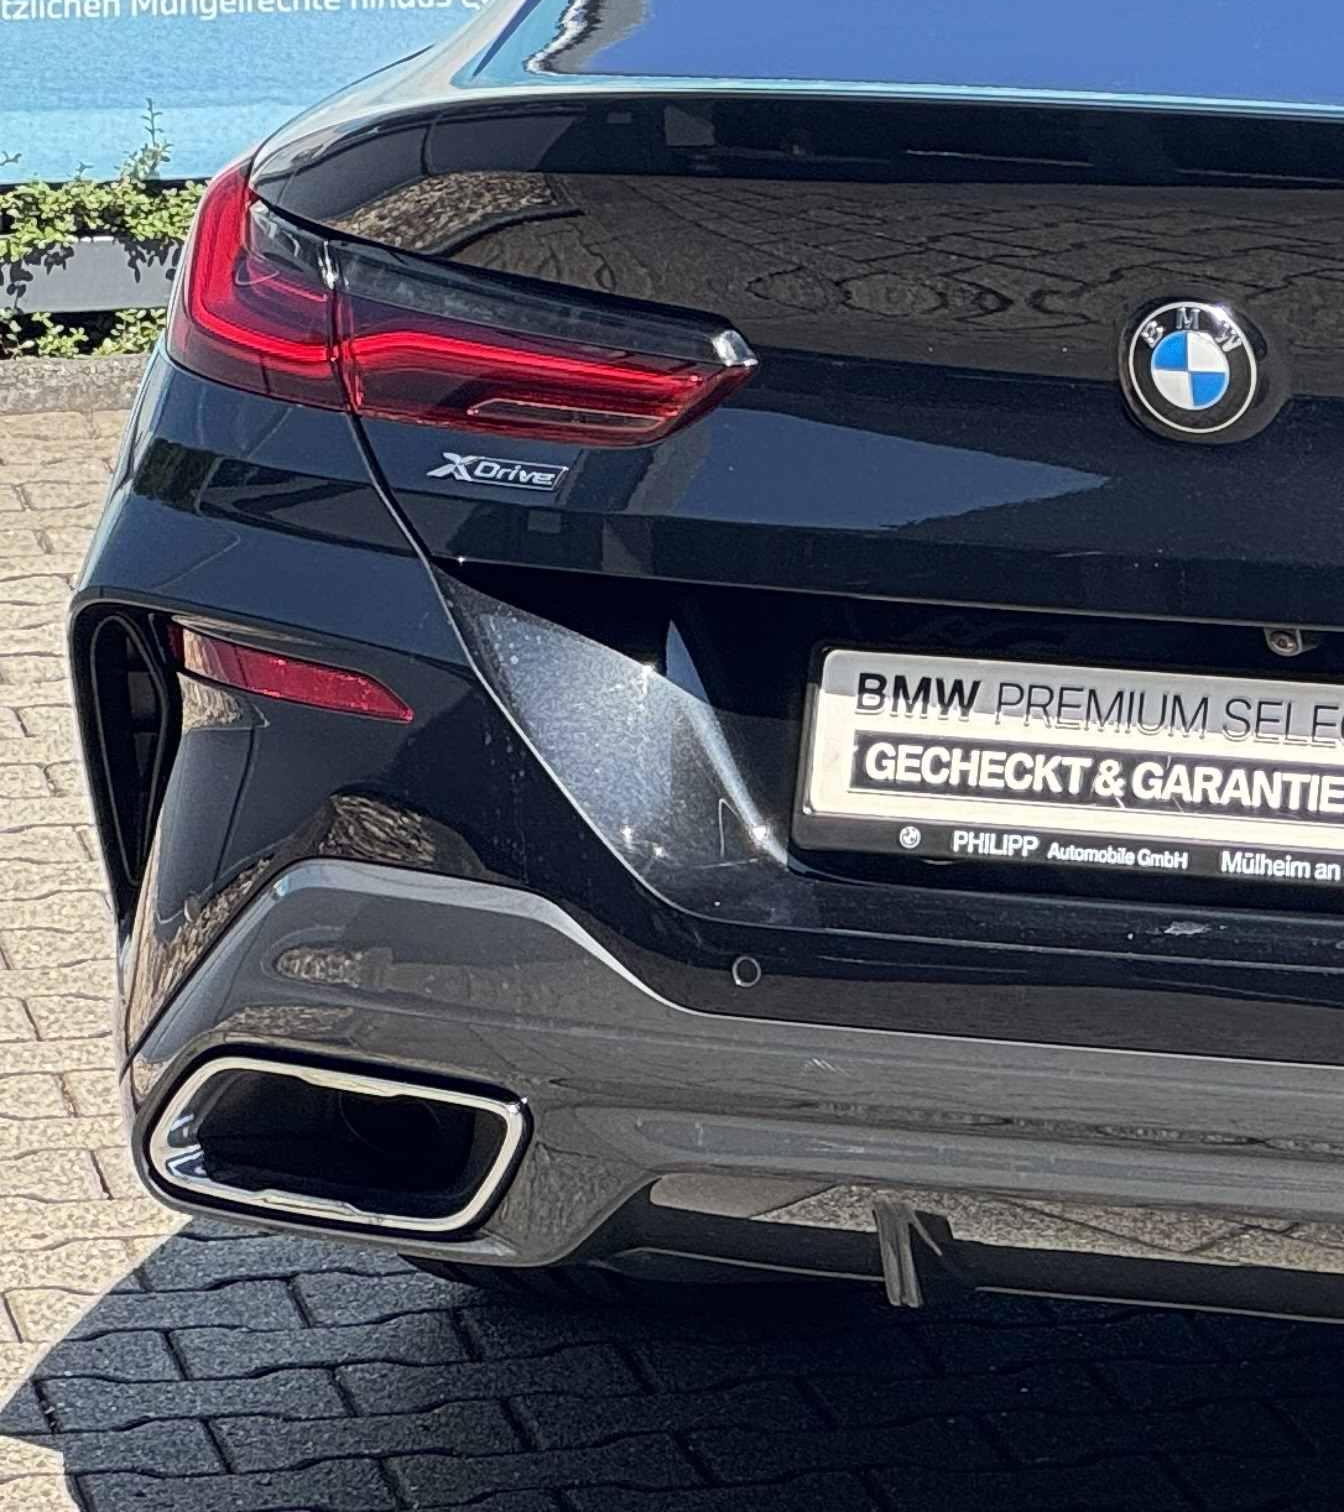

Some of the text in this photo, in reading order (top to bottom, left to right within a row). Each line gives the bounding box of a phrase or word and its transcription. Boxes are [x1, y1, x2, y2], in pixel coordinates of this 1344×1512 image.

[1141, 306, 1243, 353] BMW
[855, 672, 983, 720] BMW
[994, 682, 1210, 739] PREMIUM
[865, 741, 1092, 795] GECHECKT
[1094, 759, 1126, 797] &
[952, 829, 1040, 857] PHILIPP
[1047, 841, 1136, 866] Automobile
[1137, 848, 1189, 870] GmbH
[1220, 850, 1311, 879] Mülheim
[1314, 862, 1341, 881] an
